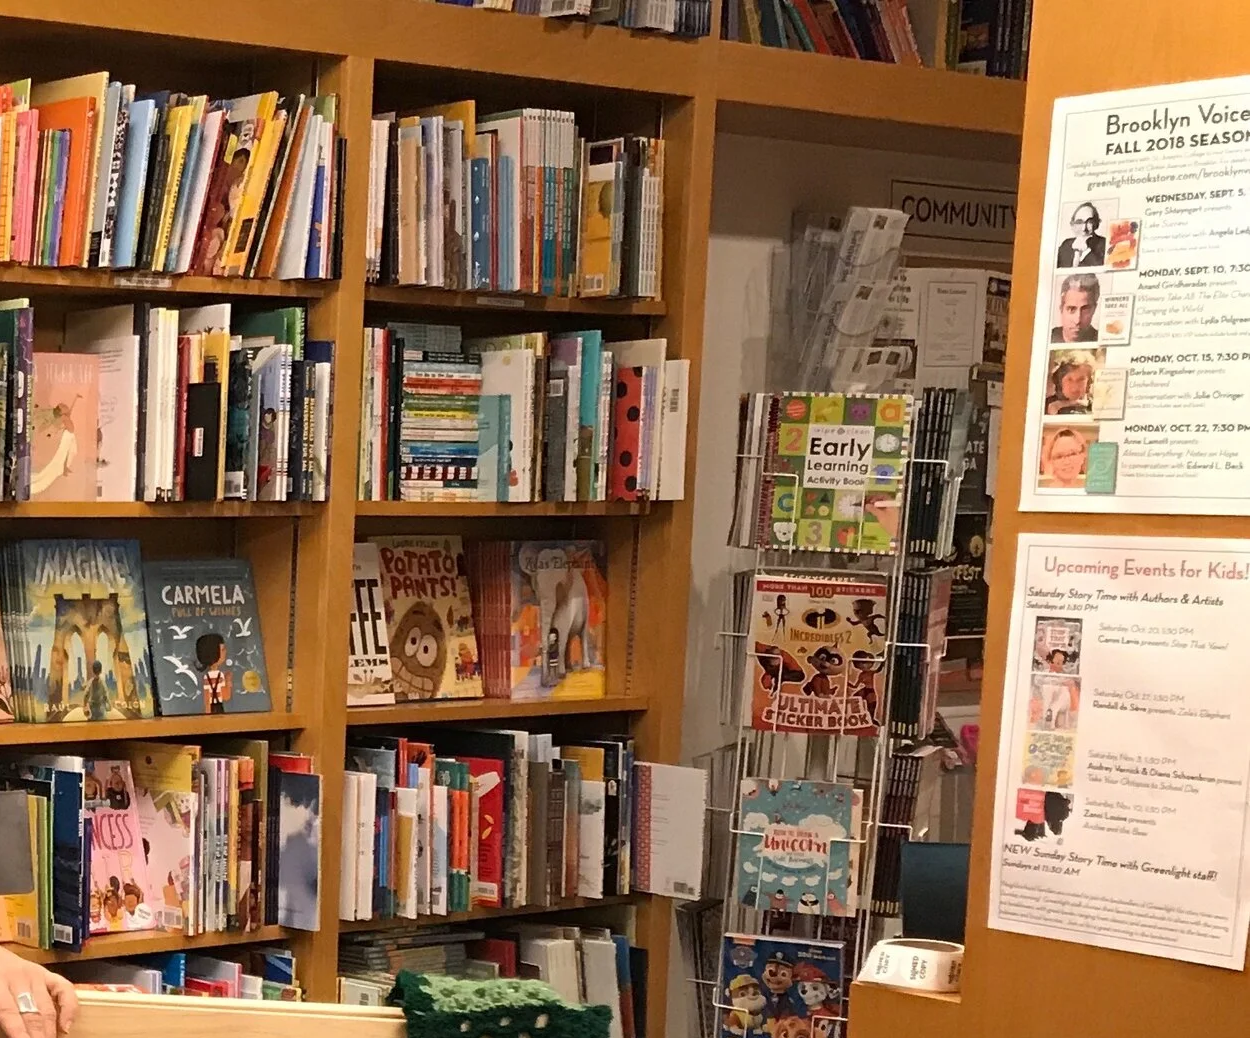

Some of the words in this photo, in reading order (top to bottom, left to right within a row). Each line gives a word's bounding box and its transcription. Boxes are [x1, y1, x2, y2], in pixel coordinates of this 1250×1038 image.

[1106, 108, 1190, 135] Brooklyn
[1198, 103, 1250, 124] Voice
[1106, 140, 1141, 155] FALL
[1146, 136, 1185, 151] 2018
[1146, 191, 1207, 203] WEDNESDAY,
[1139, 268, 1182, 278] MONDAY,
[1130, 355, 1173, 364] MONDAY,
[1176, 354, 1199, 363] OCT.
[1217, 353, 1239, 361] 7:30
[1124, 424, 1167, 434] MONDAY,
[1170, 424, 1192, 432] OCT.
[1212, 423, 1235, 432] 7:30
[810, 437, 871, 461] Early
[807, 461, 869, 475] Learning
[807, 476, 840, 486] Activity
[843, 477, 865, 485] Book
[380, 547, 458, 575] POTATO
[1044, 556, 1119, 580] Upcoming
[1123, 559, 1176, 578] Events
[1180, 560, 1202, 579] for
[1207, 561, 1250, 580] Kids!
[162, 585, 245, 606] CARMELA
[391, 576, 458, 600] PANTS!
[811, 586, 832, 597] 100
[1027, 587, 1067, 601] Saturday
[1068, 588, 1093, 601] Story
[1096, 590, 1117, 601] Time
[1120, 591, 1138, 602] with
[1141, 592, 1178, 604] Authors
[1192, 595, 1224, 606] Artists
[790, 628, 844, 644] INCREDIBLES
[777, 697, 860, 714] ULTIMATE
[764, 710, 823, 727] STICKER
[828, 713, 869, 727] BOOK
[1004, 843, 1033, 855] NEW
[1033, 847, 1065, 862] Sunday
[1069, 852, 1093, 866] Story
[1097, 855, 1117, 868] Time
[1120, 860, 1138, 871] with
[1141, 863, 1191, 879] Greenlight
